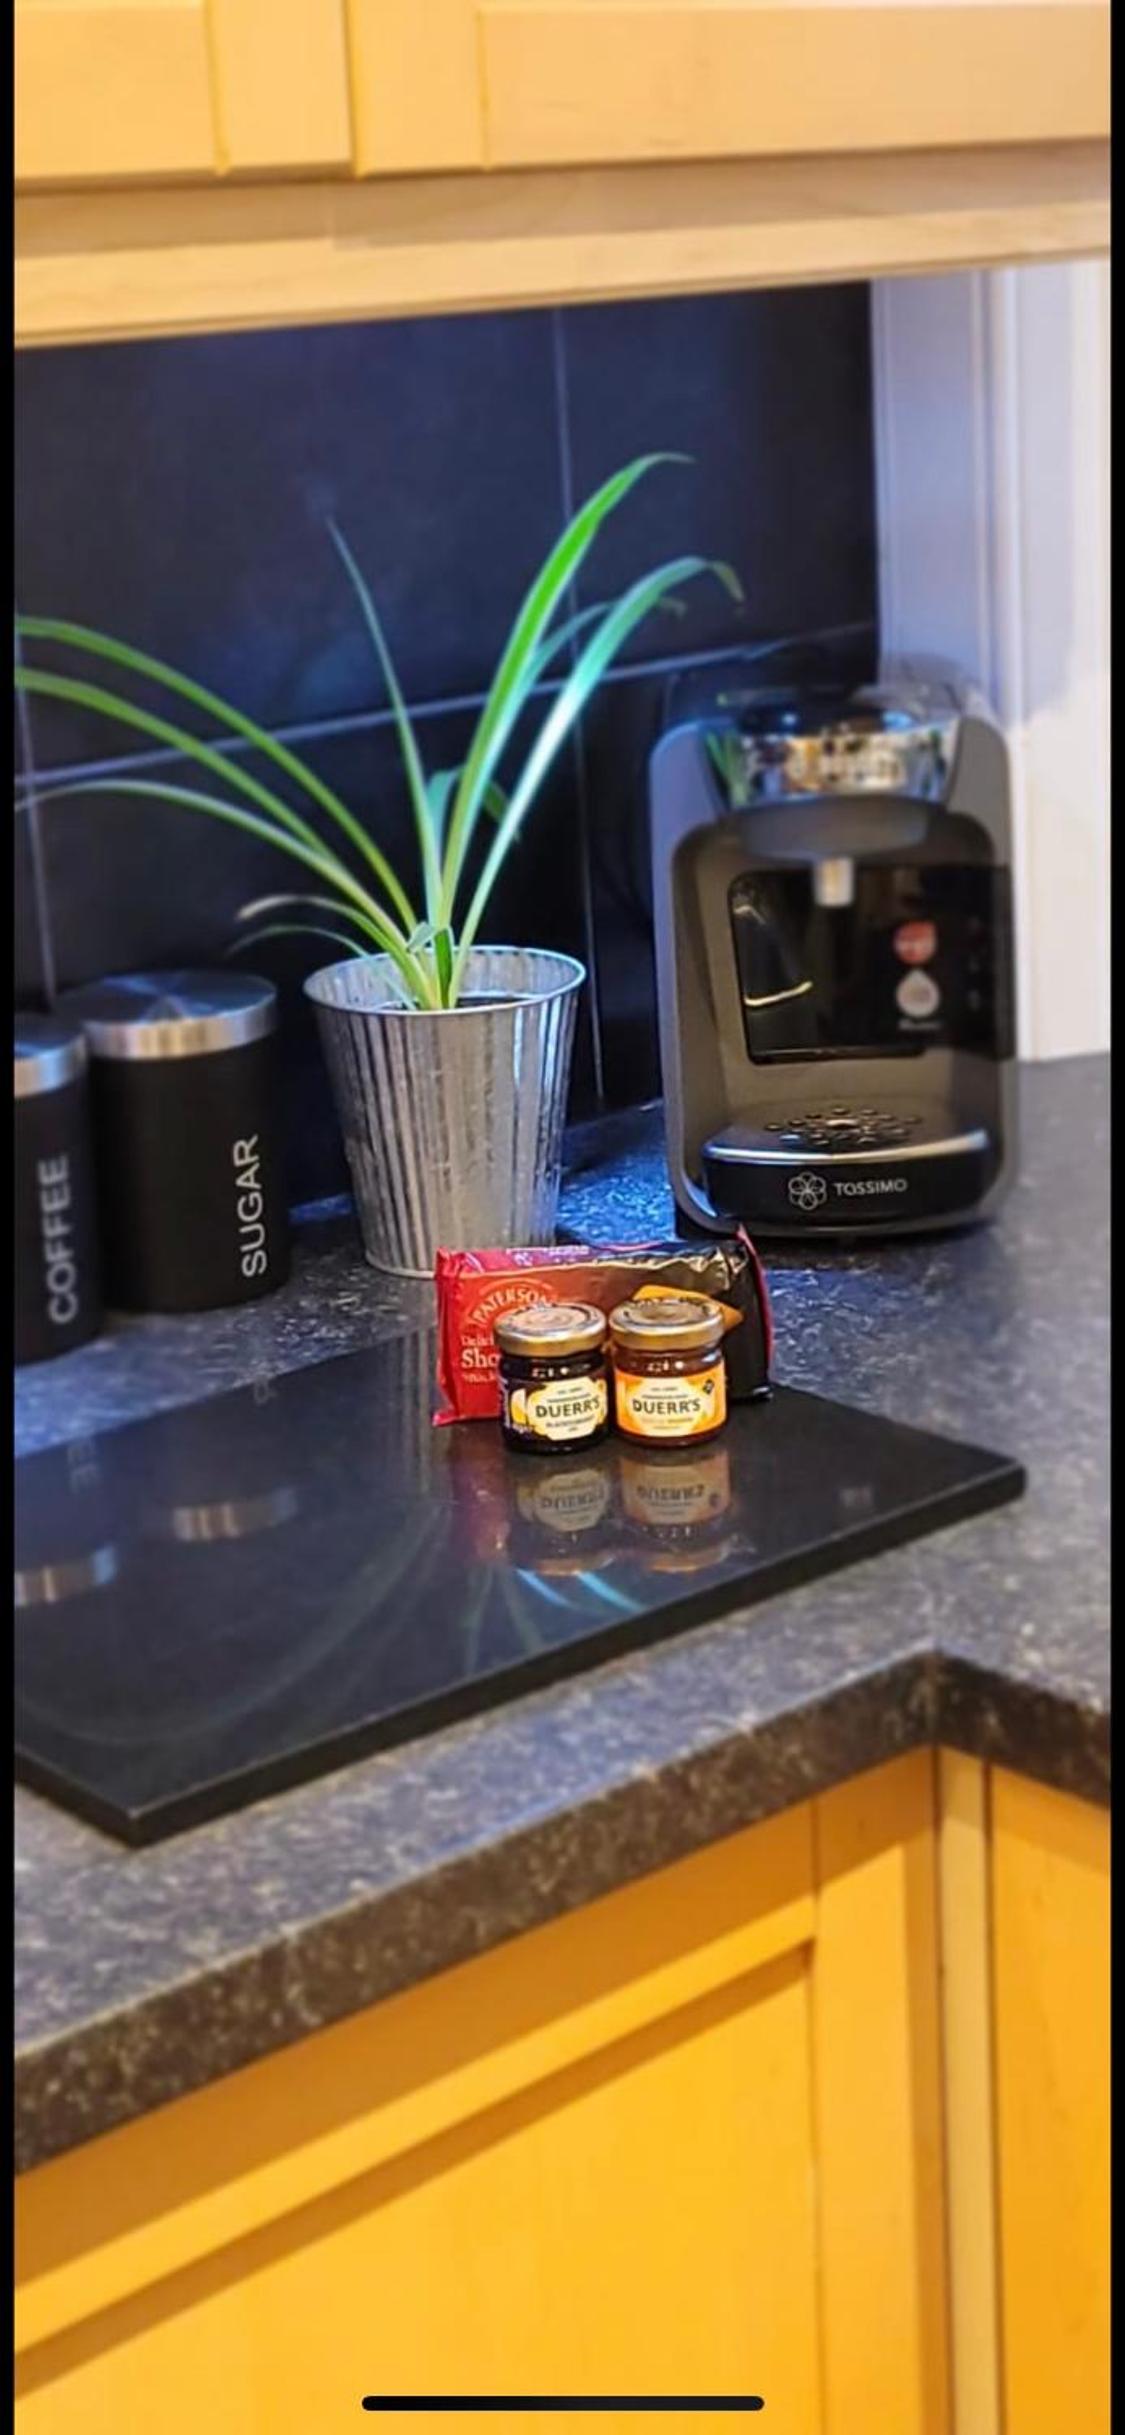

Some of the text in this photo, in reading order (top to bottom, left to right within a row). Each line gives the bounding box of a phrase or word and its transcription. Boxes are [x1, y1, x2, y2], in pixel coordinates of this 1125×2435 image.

[233, 1134, 267, 1278] SUGAR
[832, 1178, 908, 1196] TOSSIMO
[37, 1154, 79, 1324] COFFEE
[632, 1398, 701, 1415] DUERR'S
